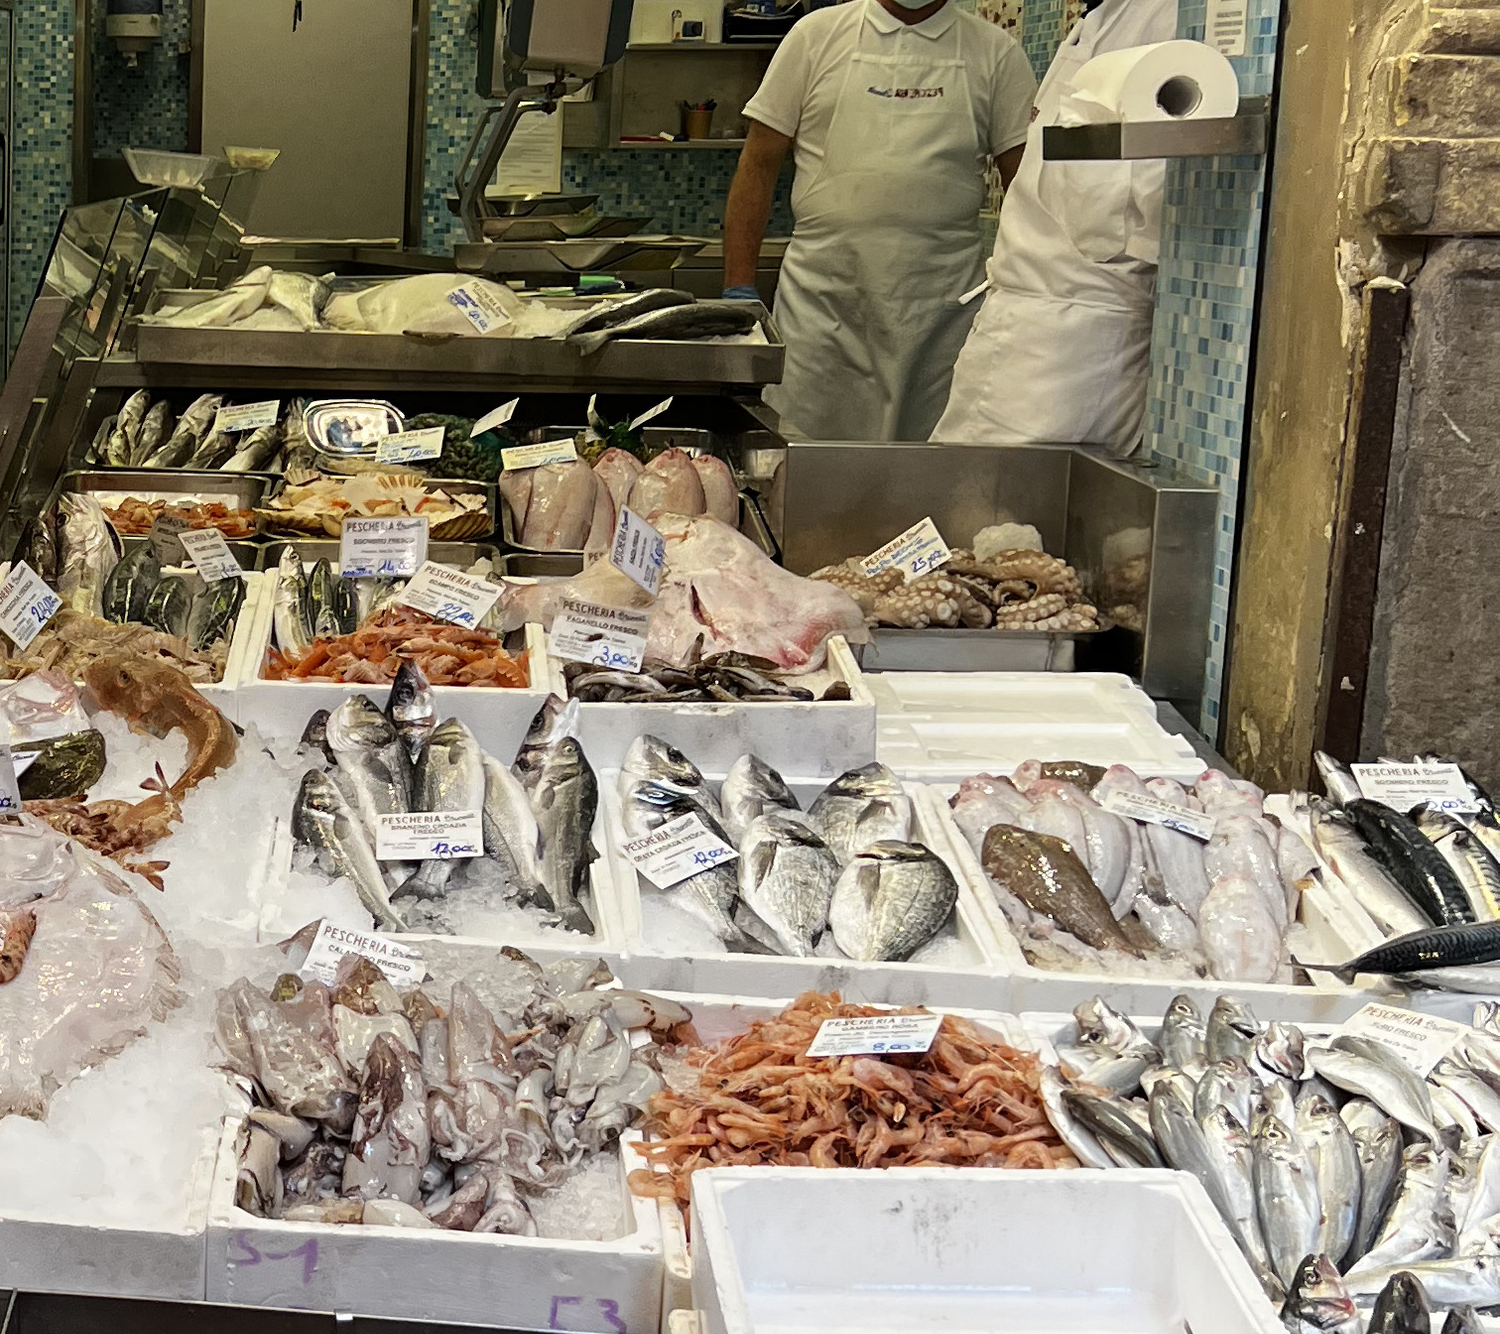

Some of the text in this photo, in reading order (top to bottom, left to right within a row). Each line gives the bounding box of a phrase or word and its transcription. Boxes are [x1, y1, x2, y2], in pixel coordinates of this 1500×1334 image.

[865, 538, 906, 567] PESCHERIA
[425, 565, 472, 587] PESCHERIA
[562, 599, 616, 619] PESCHERIA
[1358, 768, 1421, 777] PESCHERIA
[381, 815, 441, 825] PESCHERIA
[623, 829, 672, 854] PESCHERIA
[323, 925, 388, 955] PESCHERIA
[376, 958, 412, 972] FRESCO
[826, 1018, 896, 1027] PESCHERIA
[1363, 1006, 1424, 1026] PESCHERIA
[1393, 1027, 1428, 1042] FRESCO
